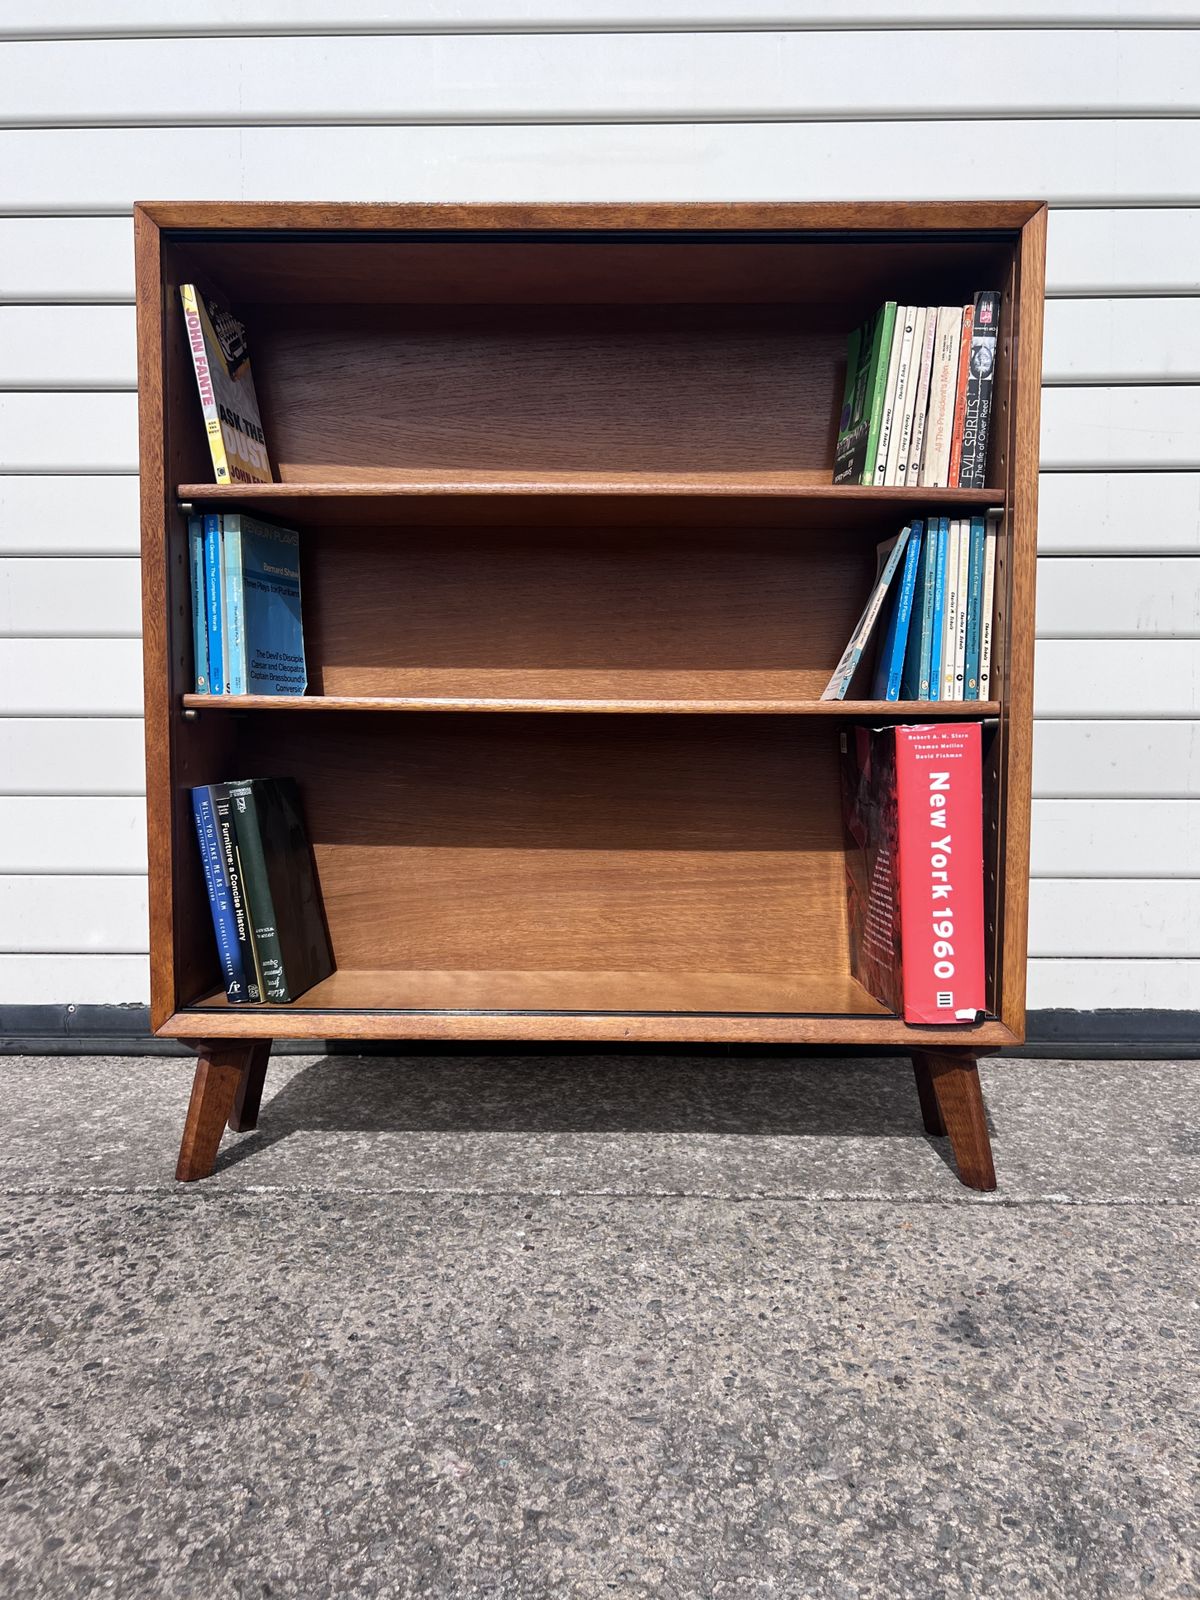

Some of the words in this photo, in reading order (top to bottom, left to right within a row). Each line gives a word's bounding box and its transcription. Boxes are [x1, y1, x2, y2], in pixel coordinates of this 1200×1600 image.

[186, 308, 204, 352] JOHN
[195, 356, 214, 406] FANTE
[980, 400, 989, 417] Reed
[219, 404, 243, 433] ASK
[242, 418, 264, 445] THE
[965, 400, 980, 447] SPIRITS
[978, 421, 987, 440] Oliver
[221, 422, 269, 472] DUST
[979, 441, 985, 450] of
[962, 454, 976, 478] EVIL
[976, 452, 985, 463] life
[975, 464, 983, 478] The
[263, 562, 283, 575] Bernard
[284, 568, 299, 578] Shaw
[257, 581, 270, 593] Plays
[256, 649, 266, 658] The
[266, 651, 282, 661] Devil's
[283, 653, 304, 663] Disciple
[250, 671, 269, 680] Captain
[269, 673, 305, 683] Brassbound's
[268, 662, 277, 670] and
[278, 663, 304, 673] Cleopatra
[275, 683, 304, 693] Conversio
[929, 772, 950, 828] New
[209, 841, 218, 860] TAKE
[221, 822, 234, 865] Furniture:
[214, 864, 220, 874] ME
[930, 838, 953, 899] York
[215, 878, 222, 887] AS
[230, 873, 241, 908] Concise
[220, 900, 227, 910] AM
[235, 909, 246, 941] History
[219, 918, 228, 948] MICHELLE
[225, 953, 234, 975] MERCER
[932, 910, 955, 979] 1960
